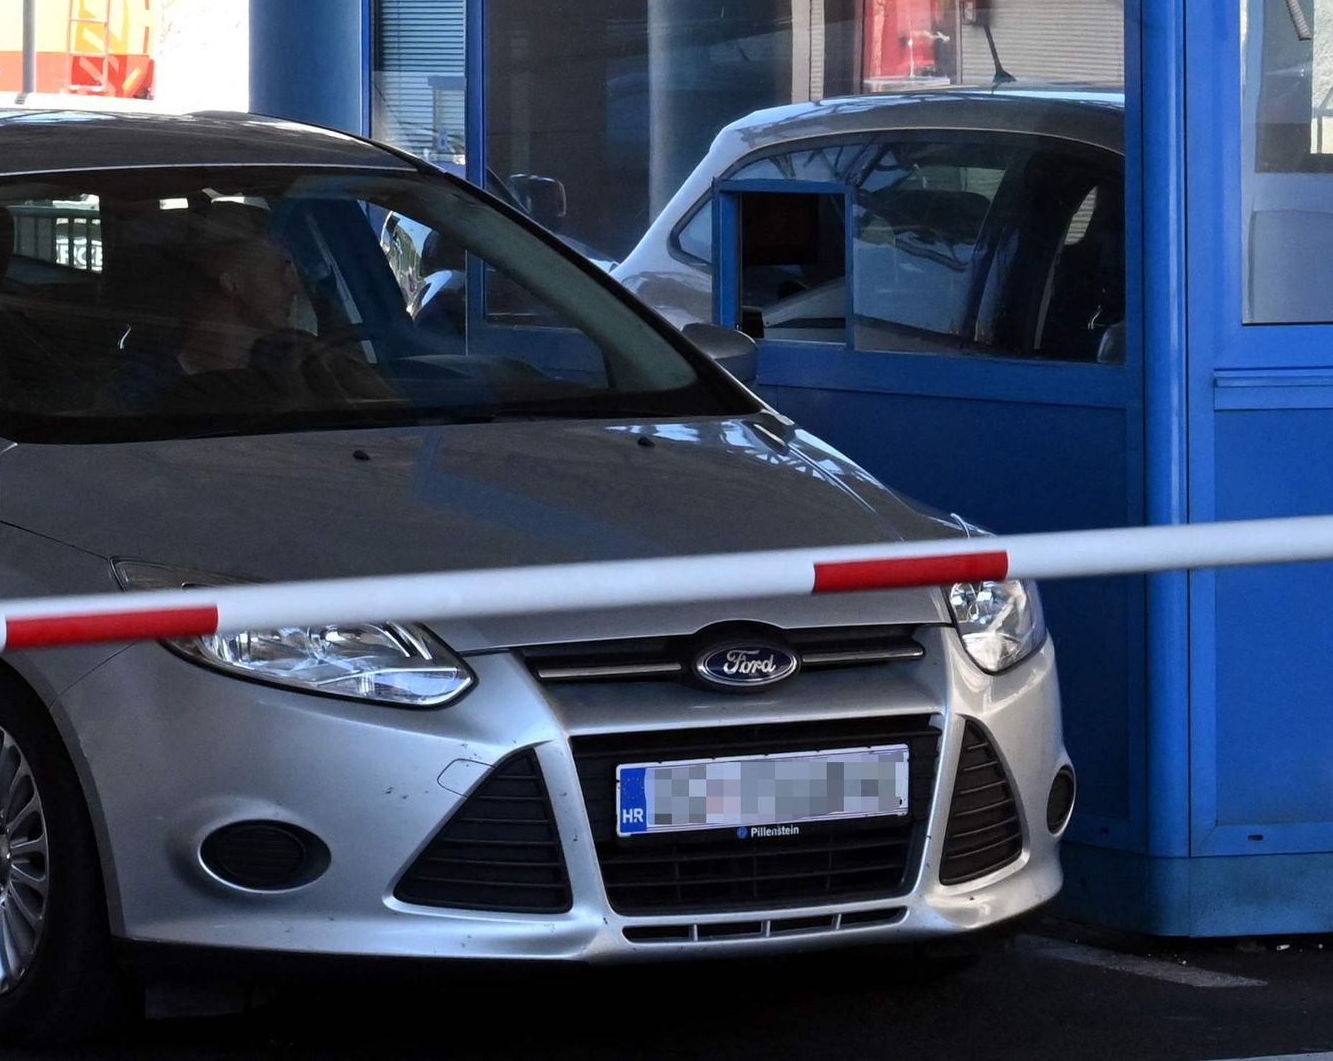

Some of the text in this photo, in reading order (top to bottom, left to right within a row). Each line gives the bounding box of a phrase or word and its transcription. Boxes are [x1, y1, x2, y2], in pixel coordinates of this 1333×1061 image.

[723, 649, 776, 675] Ford
[623, 808, 644, 824] HR
[750, 824, 800, 838] Pillenstein
